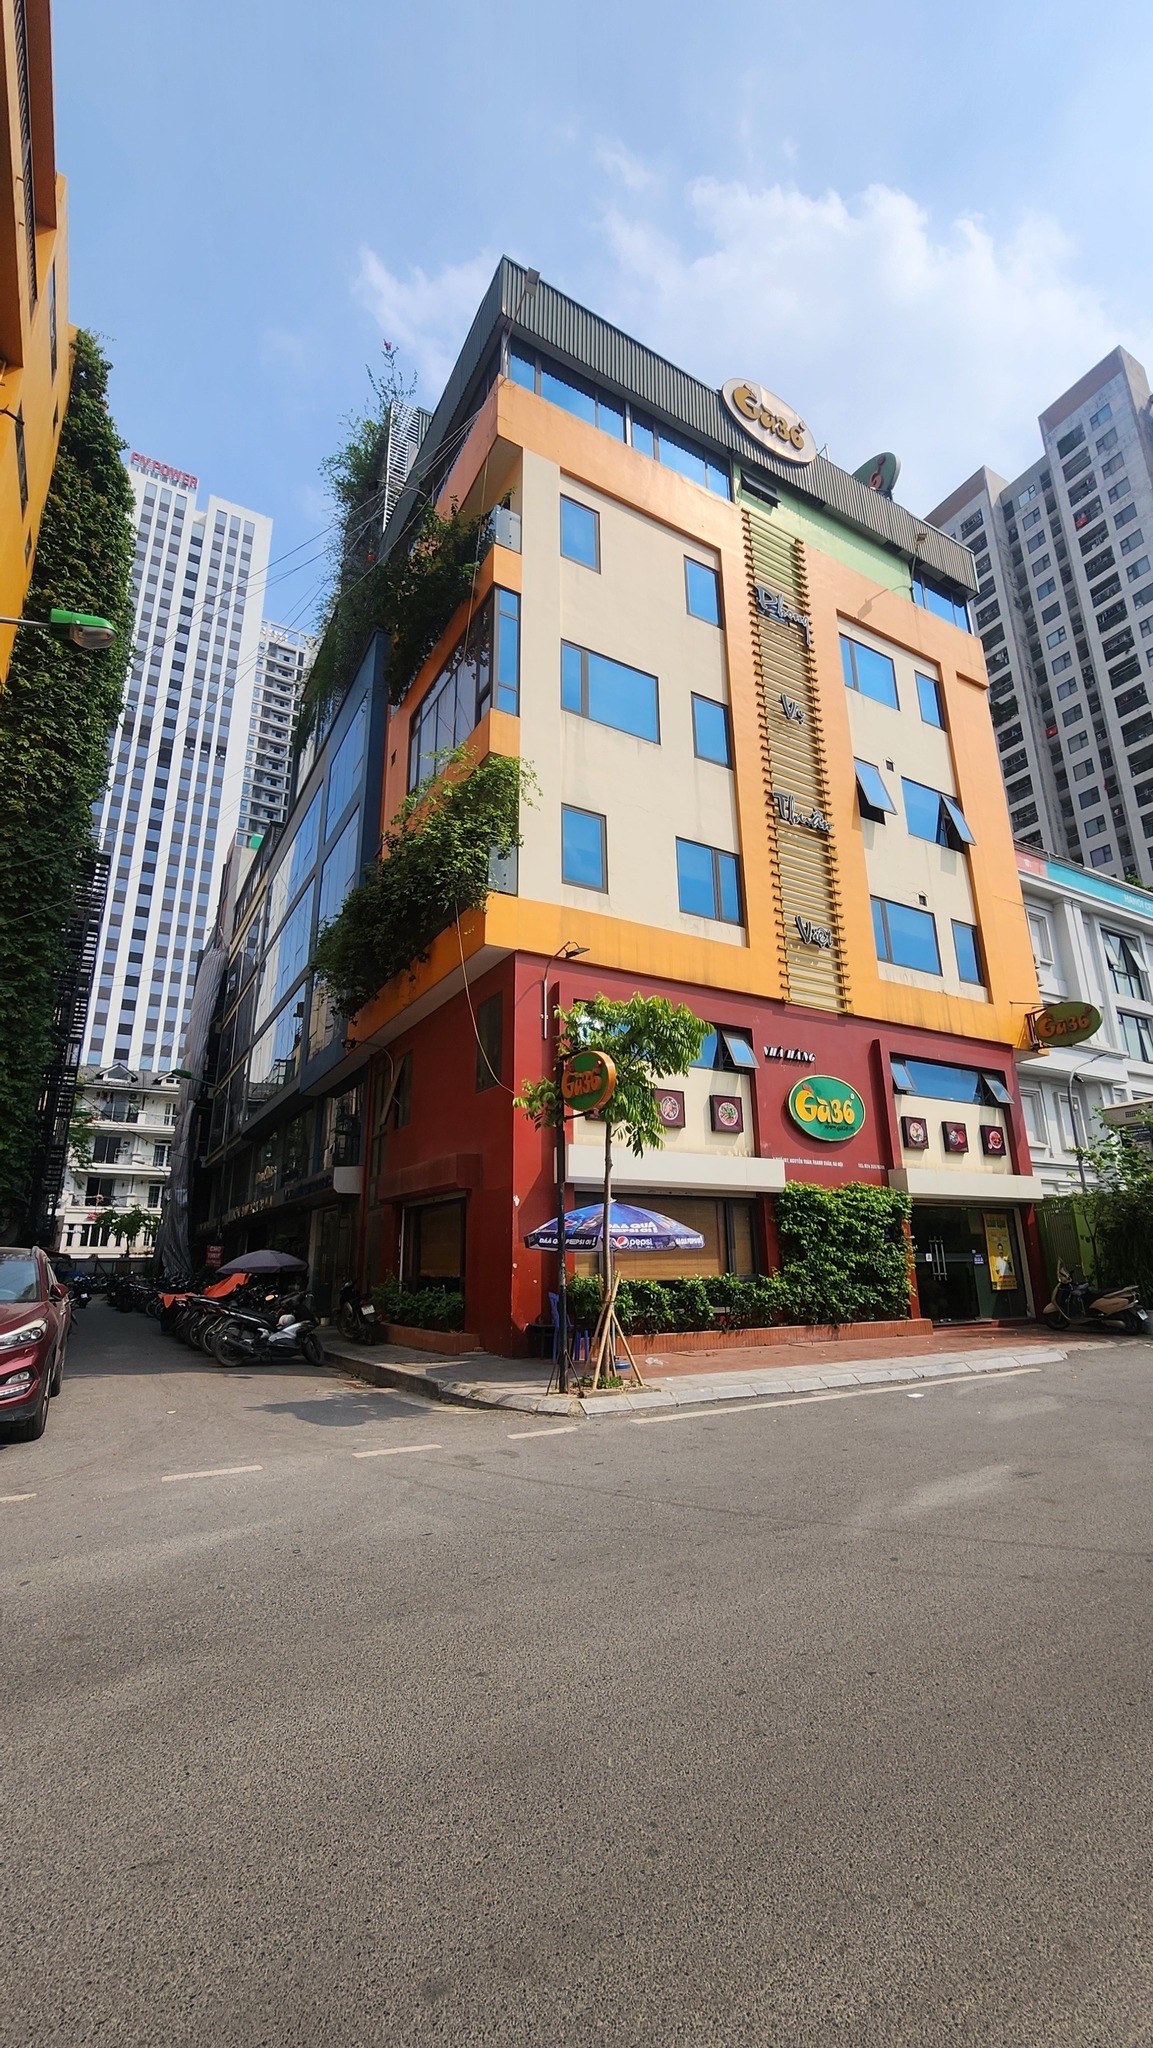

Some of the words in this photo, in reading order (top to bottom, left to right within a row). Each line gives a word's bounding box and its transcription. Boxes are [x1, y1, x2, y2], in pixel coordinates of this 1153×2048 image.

[131, 451, 151, 468] PV
[152, 460, 198, 489] POWER
[755, 584, 811, 646] Phong
[786, 1048, 815, 1061] HÀNG
[795, 1088, 855, 1125] Gà36
[629, 1238, 653, 1247] pepsi
